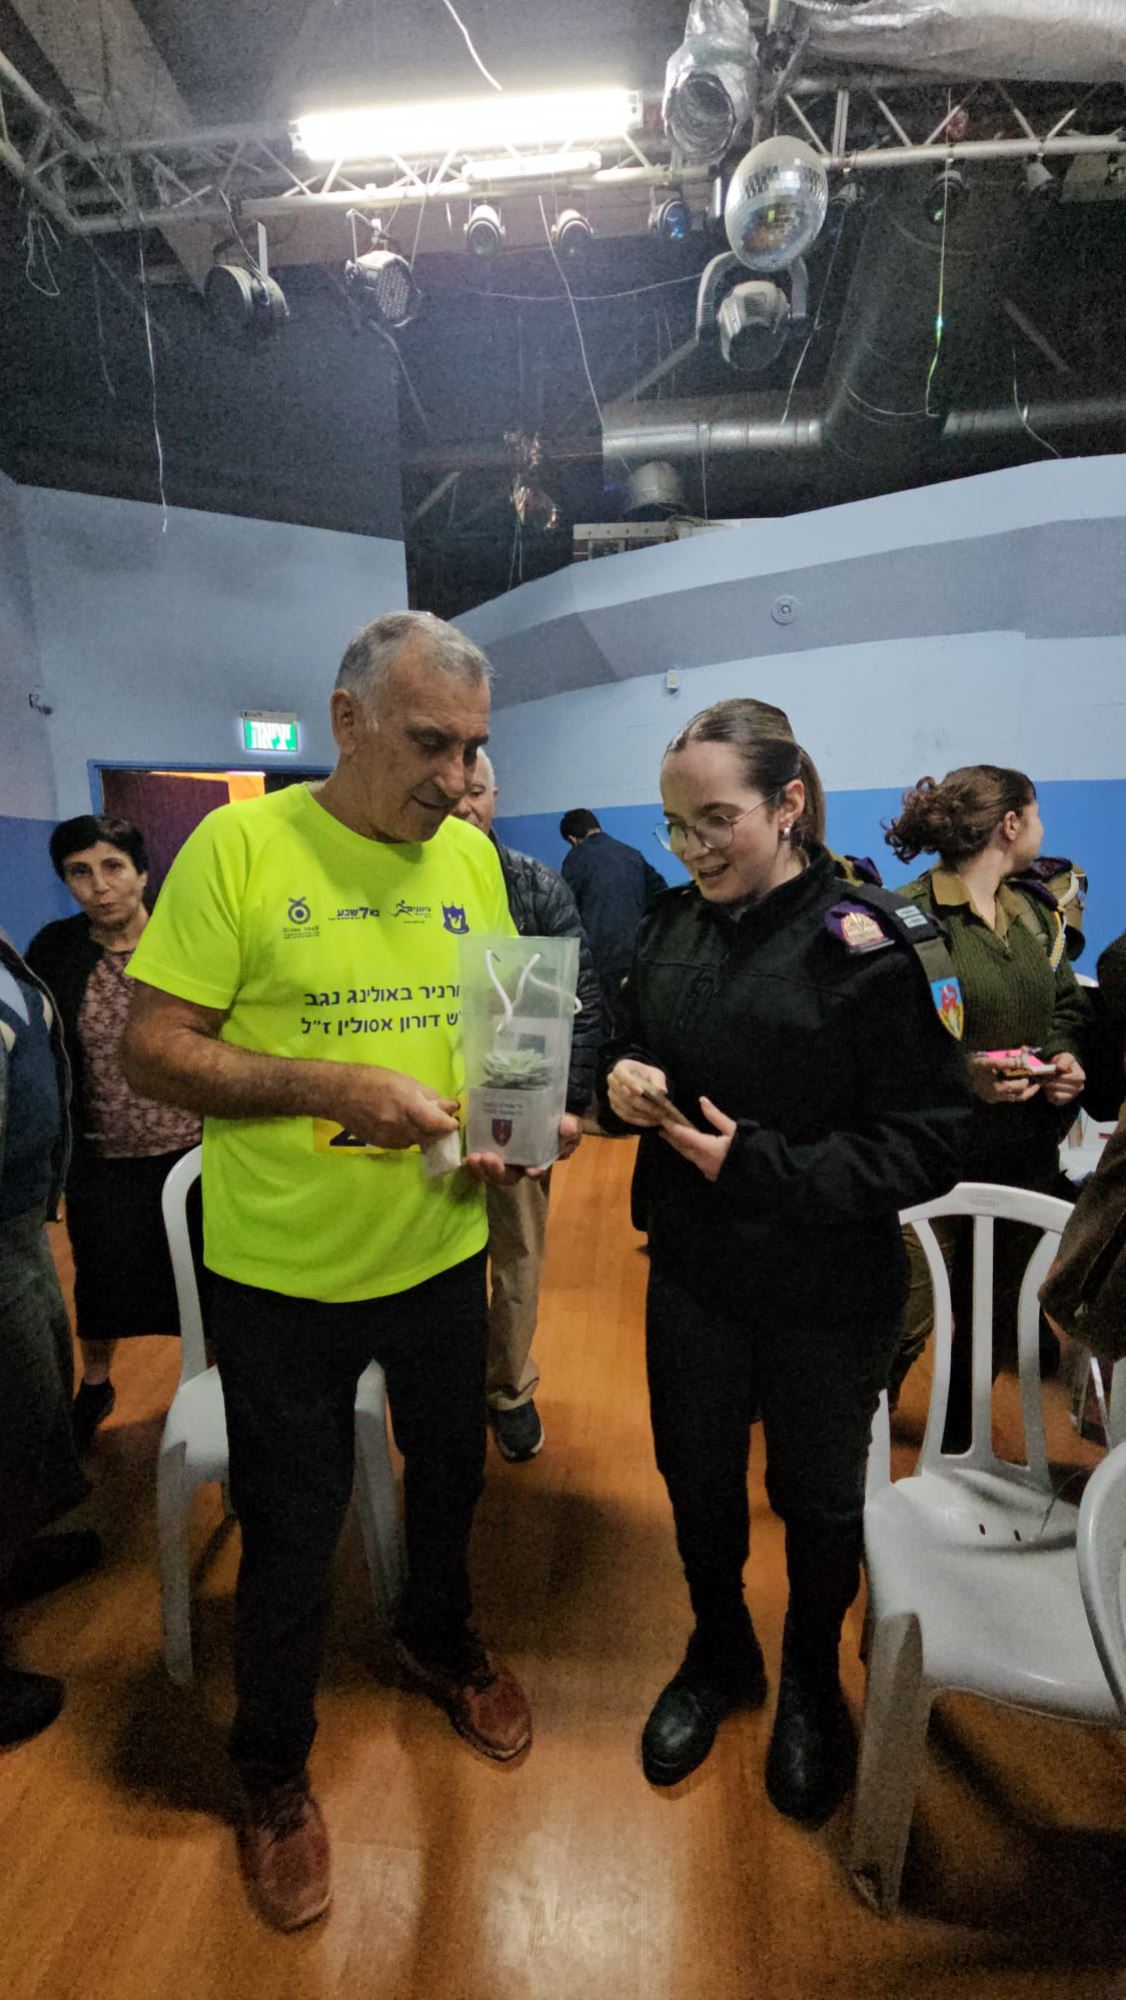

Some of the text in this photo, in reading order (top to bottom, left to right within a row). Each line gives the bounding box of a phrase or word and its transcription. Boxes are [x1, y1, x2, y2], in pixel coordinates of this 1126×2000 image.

[304, 985, 460, 1006] ורניר באולינג נגב
[338, 1017, 393, 1036] אסולין
[400, 1014, 441, 1033] דורון
